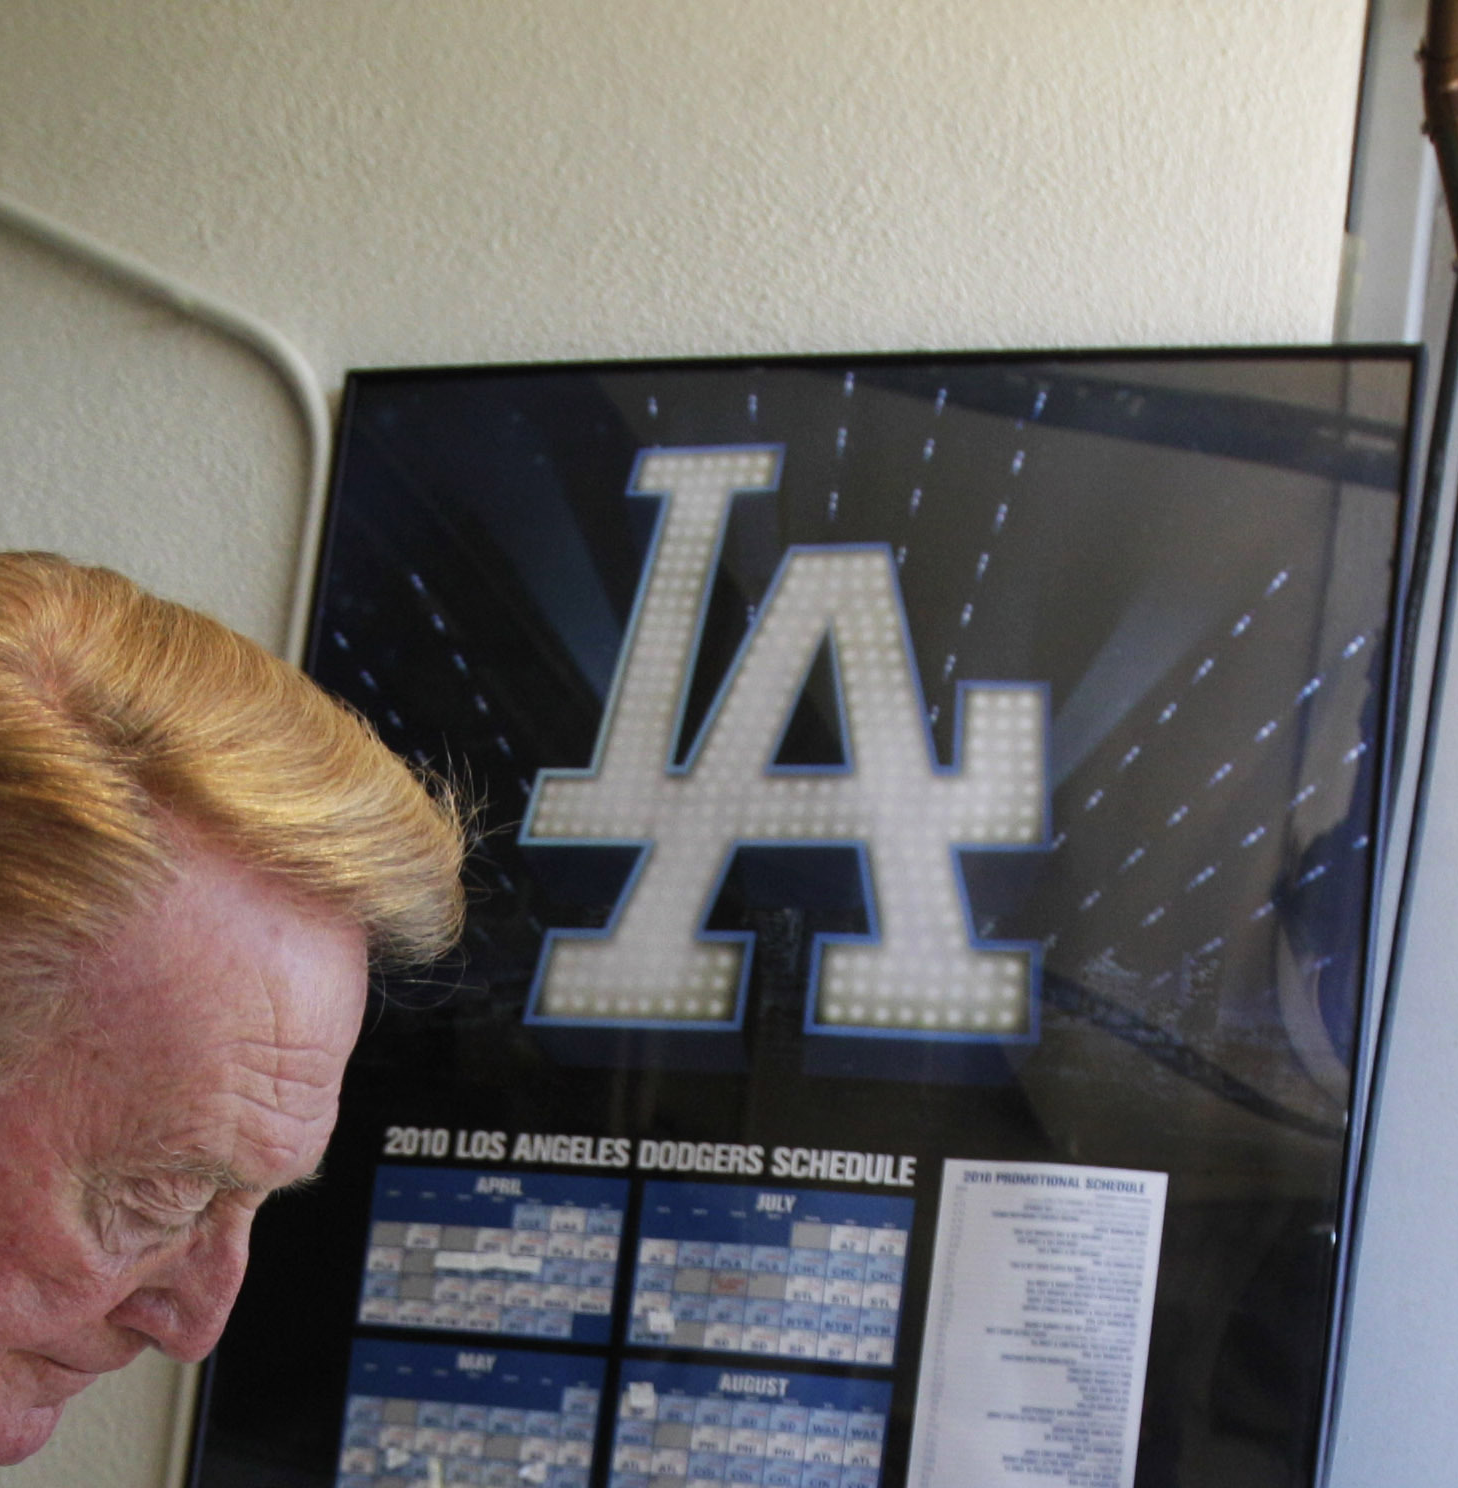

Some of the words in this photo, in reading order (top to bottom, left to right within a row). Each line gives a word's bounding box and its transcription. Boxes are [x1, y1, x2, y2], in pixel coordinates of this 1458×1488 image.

[520, 443, 1050, 1042] LA
[385, 1126, 450, 1155] 2010
[456, 1130, 507, 1160] LOS
[512, 1133, 630, 1167] ANGELES
[638, 1139, 764, 1175] DODGERS
[771, 1147, 917, 1187] SCHEDULE
[474, 1177, 522, 1195] APRIL
[964, 1170, 992, 1184] 2010
[996, 1171, 1081, 1189] PROMOTIONAL
[1085, 1178, 1148, 1194] SCHEDULE
[755, 1193, 796, 1213] JULY
[456, 1352, 496, 1371] MAY
[719, 1373, 790, 1396] AUGUST
